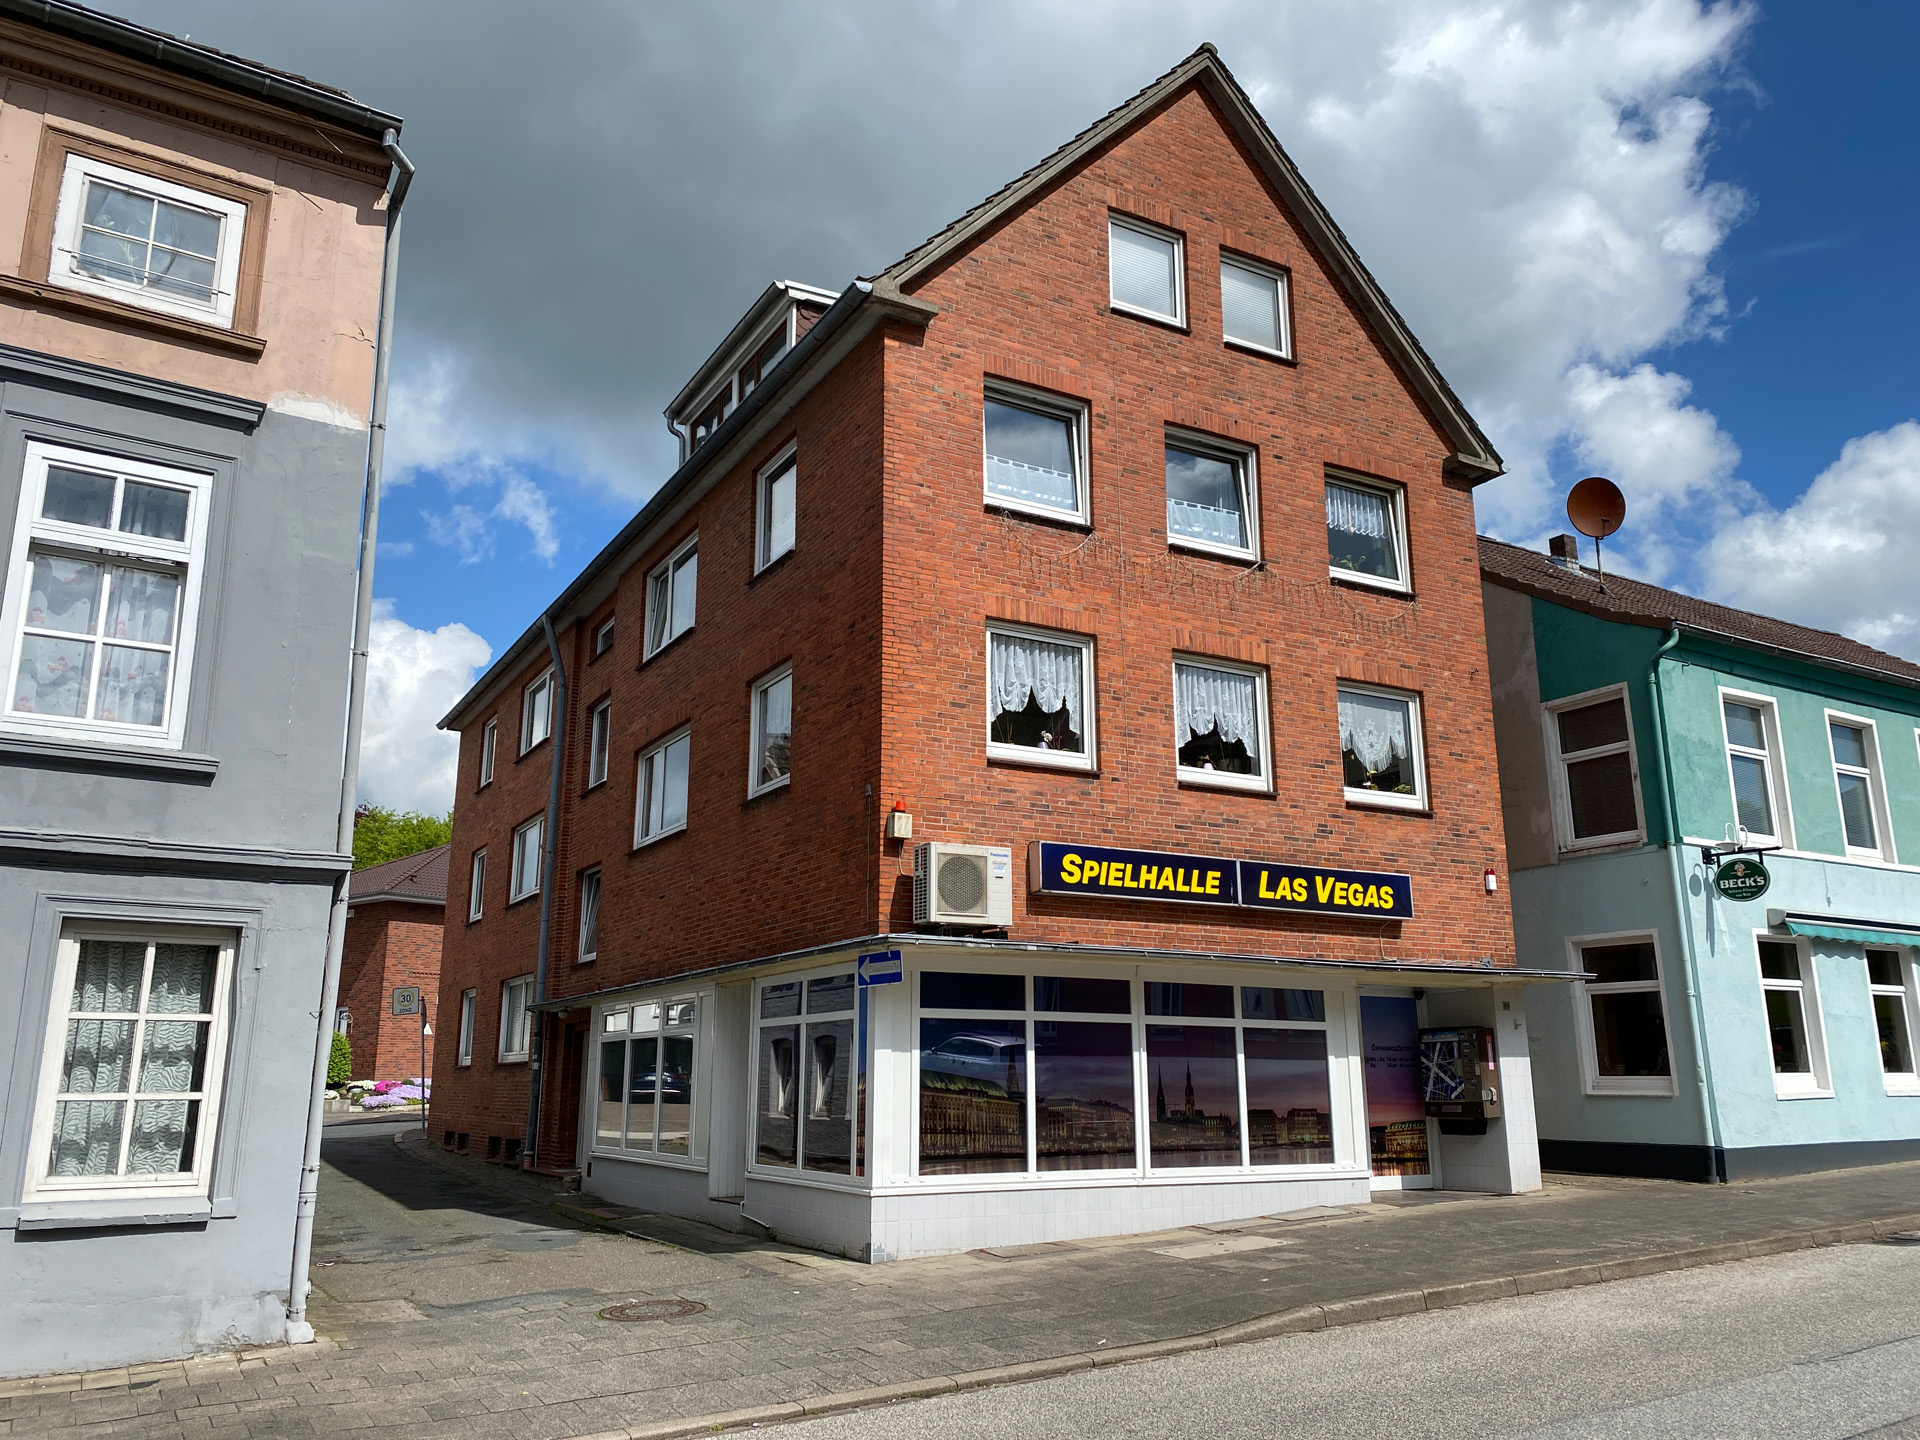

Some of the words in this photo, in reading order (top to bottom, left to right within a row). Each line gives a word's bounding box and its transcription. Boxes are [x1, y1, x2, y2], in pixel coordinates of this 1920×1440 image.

[1060, 853, 1221, 895] SPIELHALLE
[1720, 876, 1765, 888] BECK'S
[1258, 870, 1308, 902] LAS
[1315, 875, 1394, 909] VEGAS
[400, 994, 412, 1003] 30
